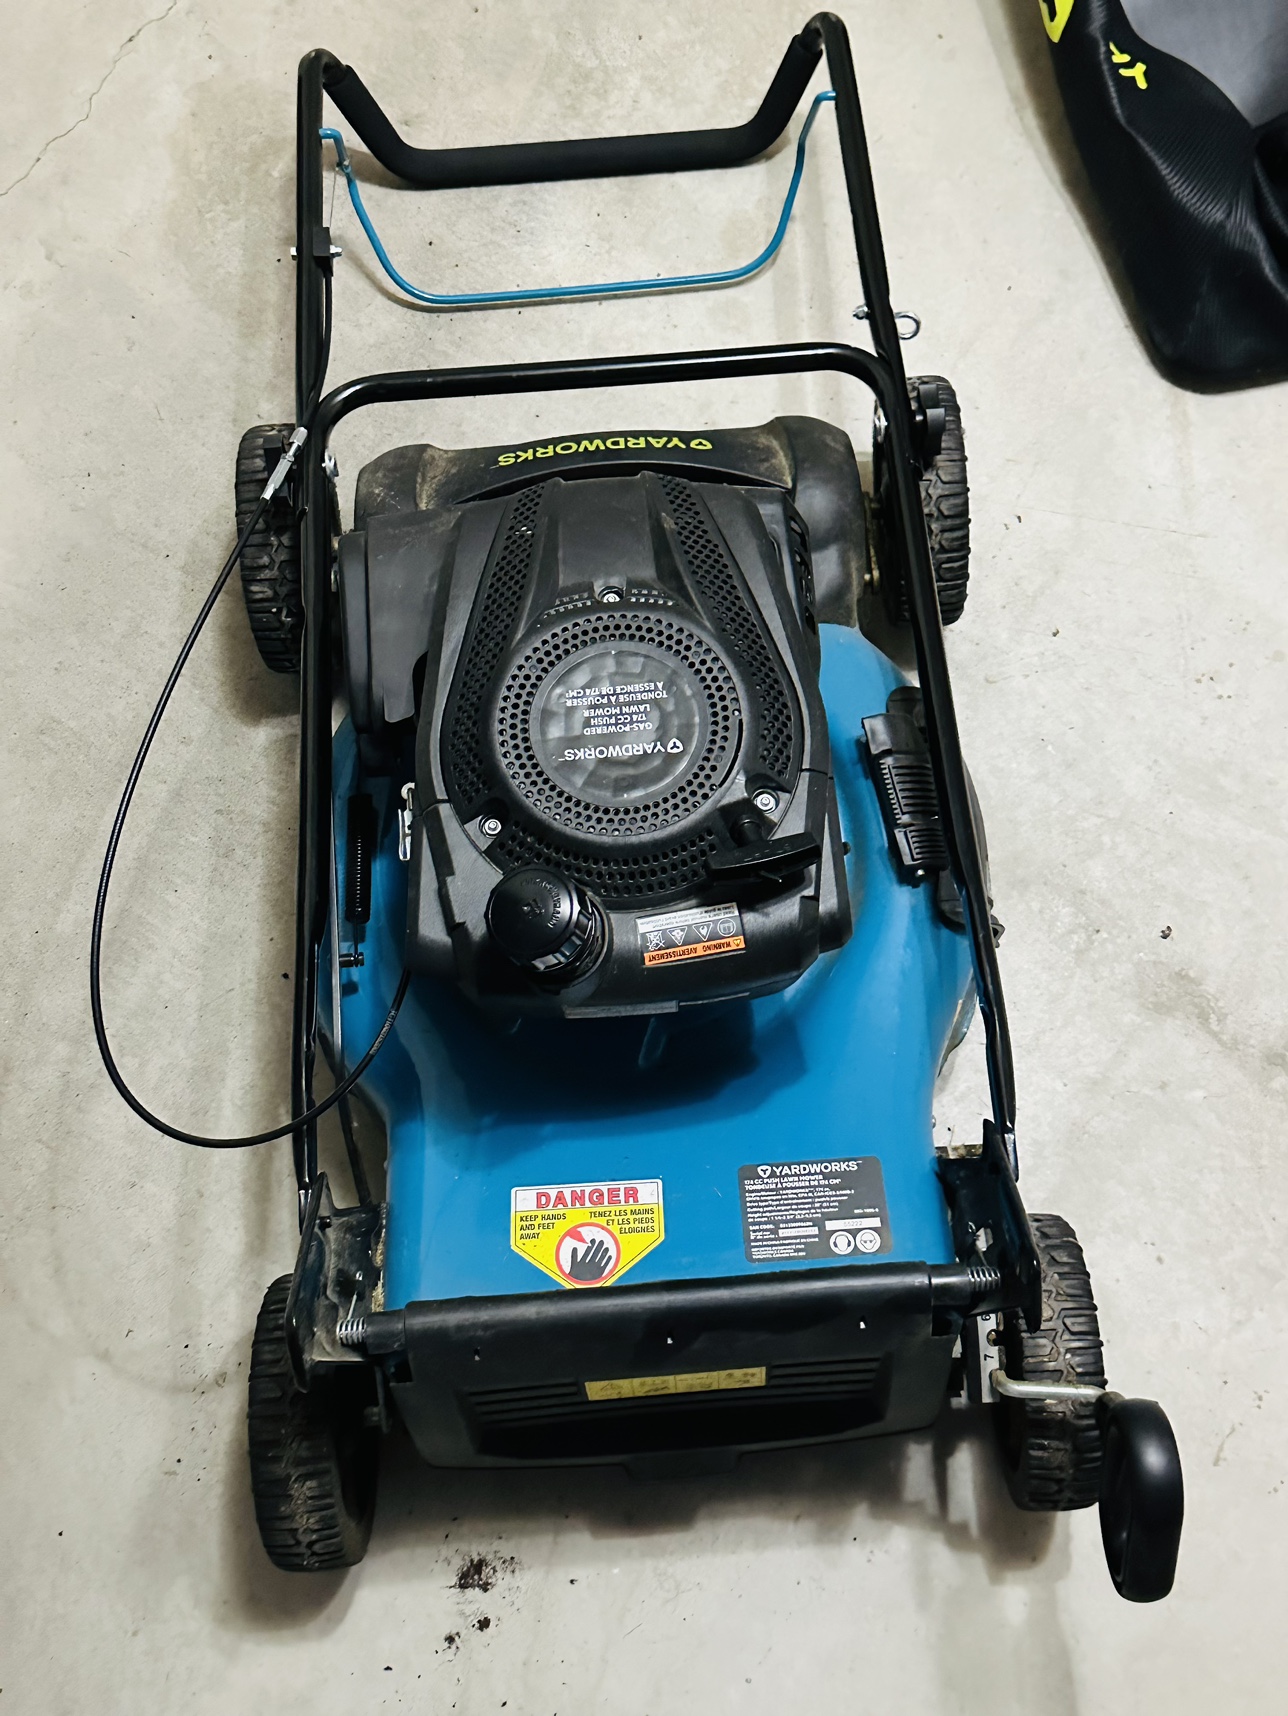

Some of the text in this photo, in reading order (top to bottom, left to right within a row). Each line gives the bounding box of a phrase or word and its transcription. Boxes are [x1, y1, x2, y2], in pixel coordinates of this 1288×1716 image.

[497, 436, 687, 467] YARDWORKS
[585, 687, 600, 695] 174
[601, 686, 614, 694] DE
[615, 682, 655, 693] ESSENCE
[566, 690, 668, 707] TONDEUSE À POUSSER
[583, 703, 650, 717] LAWN MOWER
[591, 714, 647, 726] 174 CC PUSH
[583, 722, 653, 736] GAS-POWERED
[564, 741, 666, 761] YARDWORKS
[648, 941, 732, 962] WARNING AVERTISSEMENT
[773, 1161, 858, 1176] YARDWORKS
[783, 1180, 810, 1188] POUSSER
[536, 1187, 639, 1209] DANGER
[520, 1213, 566, 1222] KEEP HANDS
[589, 1211, 612, 1219] TENEZ
[629, 1208, 655, 1216] MAINS
[520, 1222, 555, 1231] AND FEET
[606, 1216, 655, 1226] ET LES PIEDS
[520, 1232, 540, 1240] AWAY
